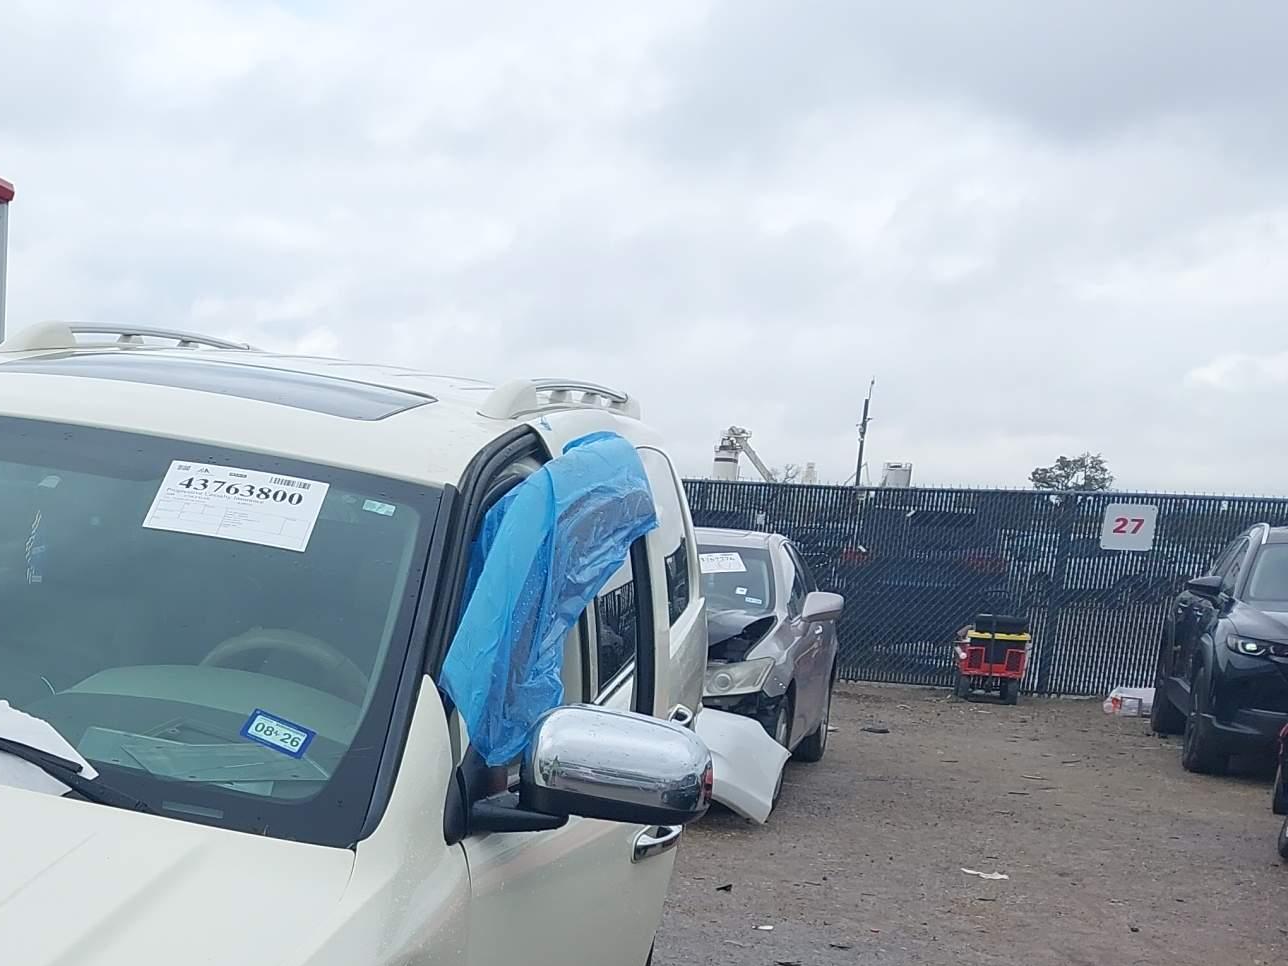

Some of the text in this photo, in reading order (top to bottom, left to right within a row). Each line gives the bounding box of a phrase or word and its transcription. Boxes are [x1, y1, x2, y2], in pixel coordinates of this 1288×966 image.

[178, 476, 304, 506] 43763800
[1112, 517, 1145, 534] 27
[254, 721, 302, 748] 08 26
